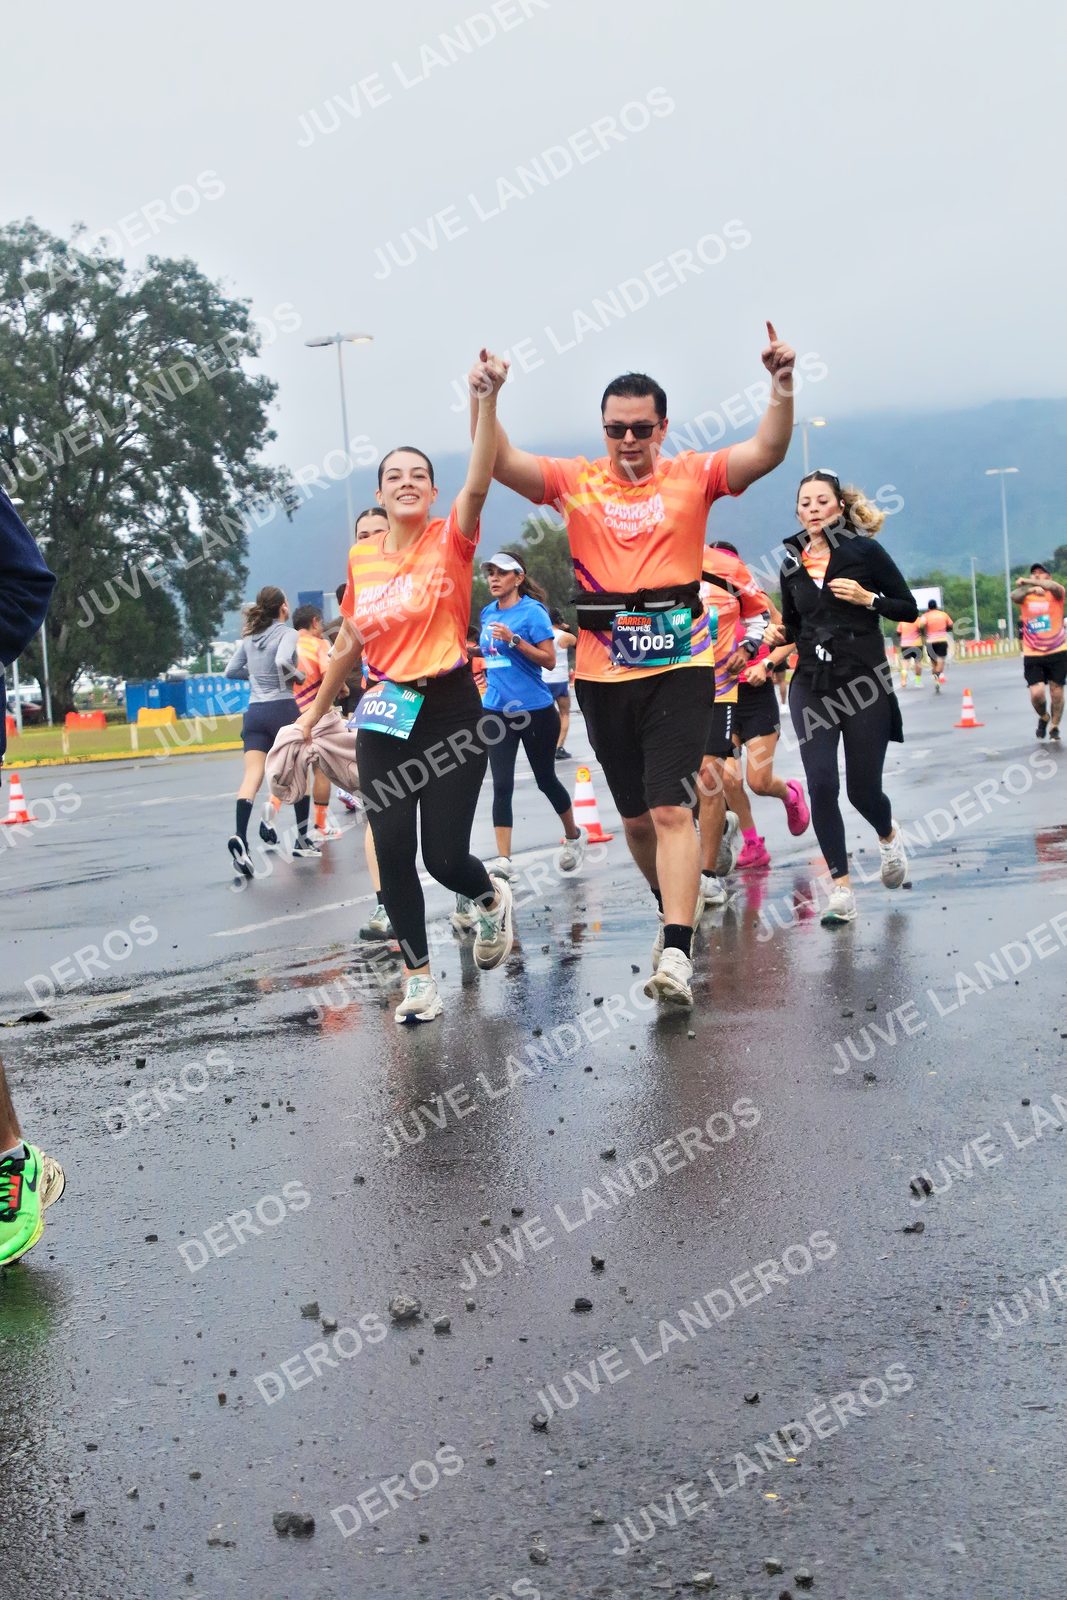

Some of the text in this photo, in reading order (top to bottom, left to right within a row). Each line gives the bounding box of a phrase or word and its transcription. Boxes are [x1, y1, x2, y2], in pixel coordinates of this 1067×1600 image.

[617, 616, 652, 626] CARRERA
[672, 614, 686, 626] 10K
[628, 634, 675, 651] 1003
[401, 690, 418, 703] 10K
[362, 700, 398, 719] 1002
